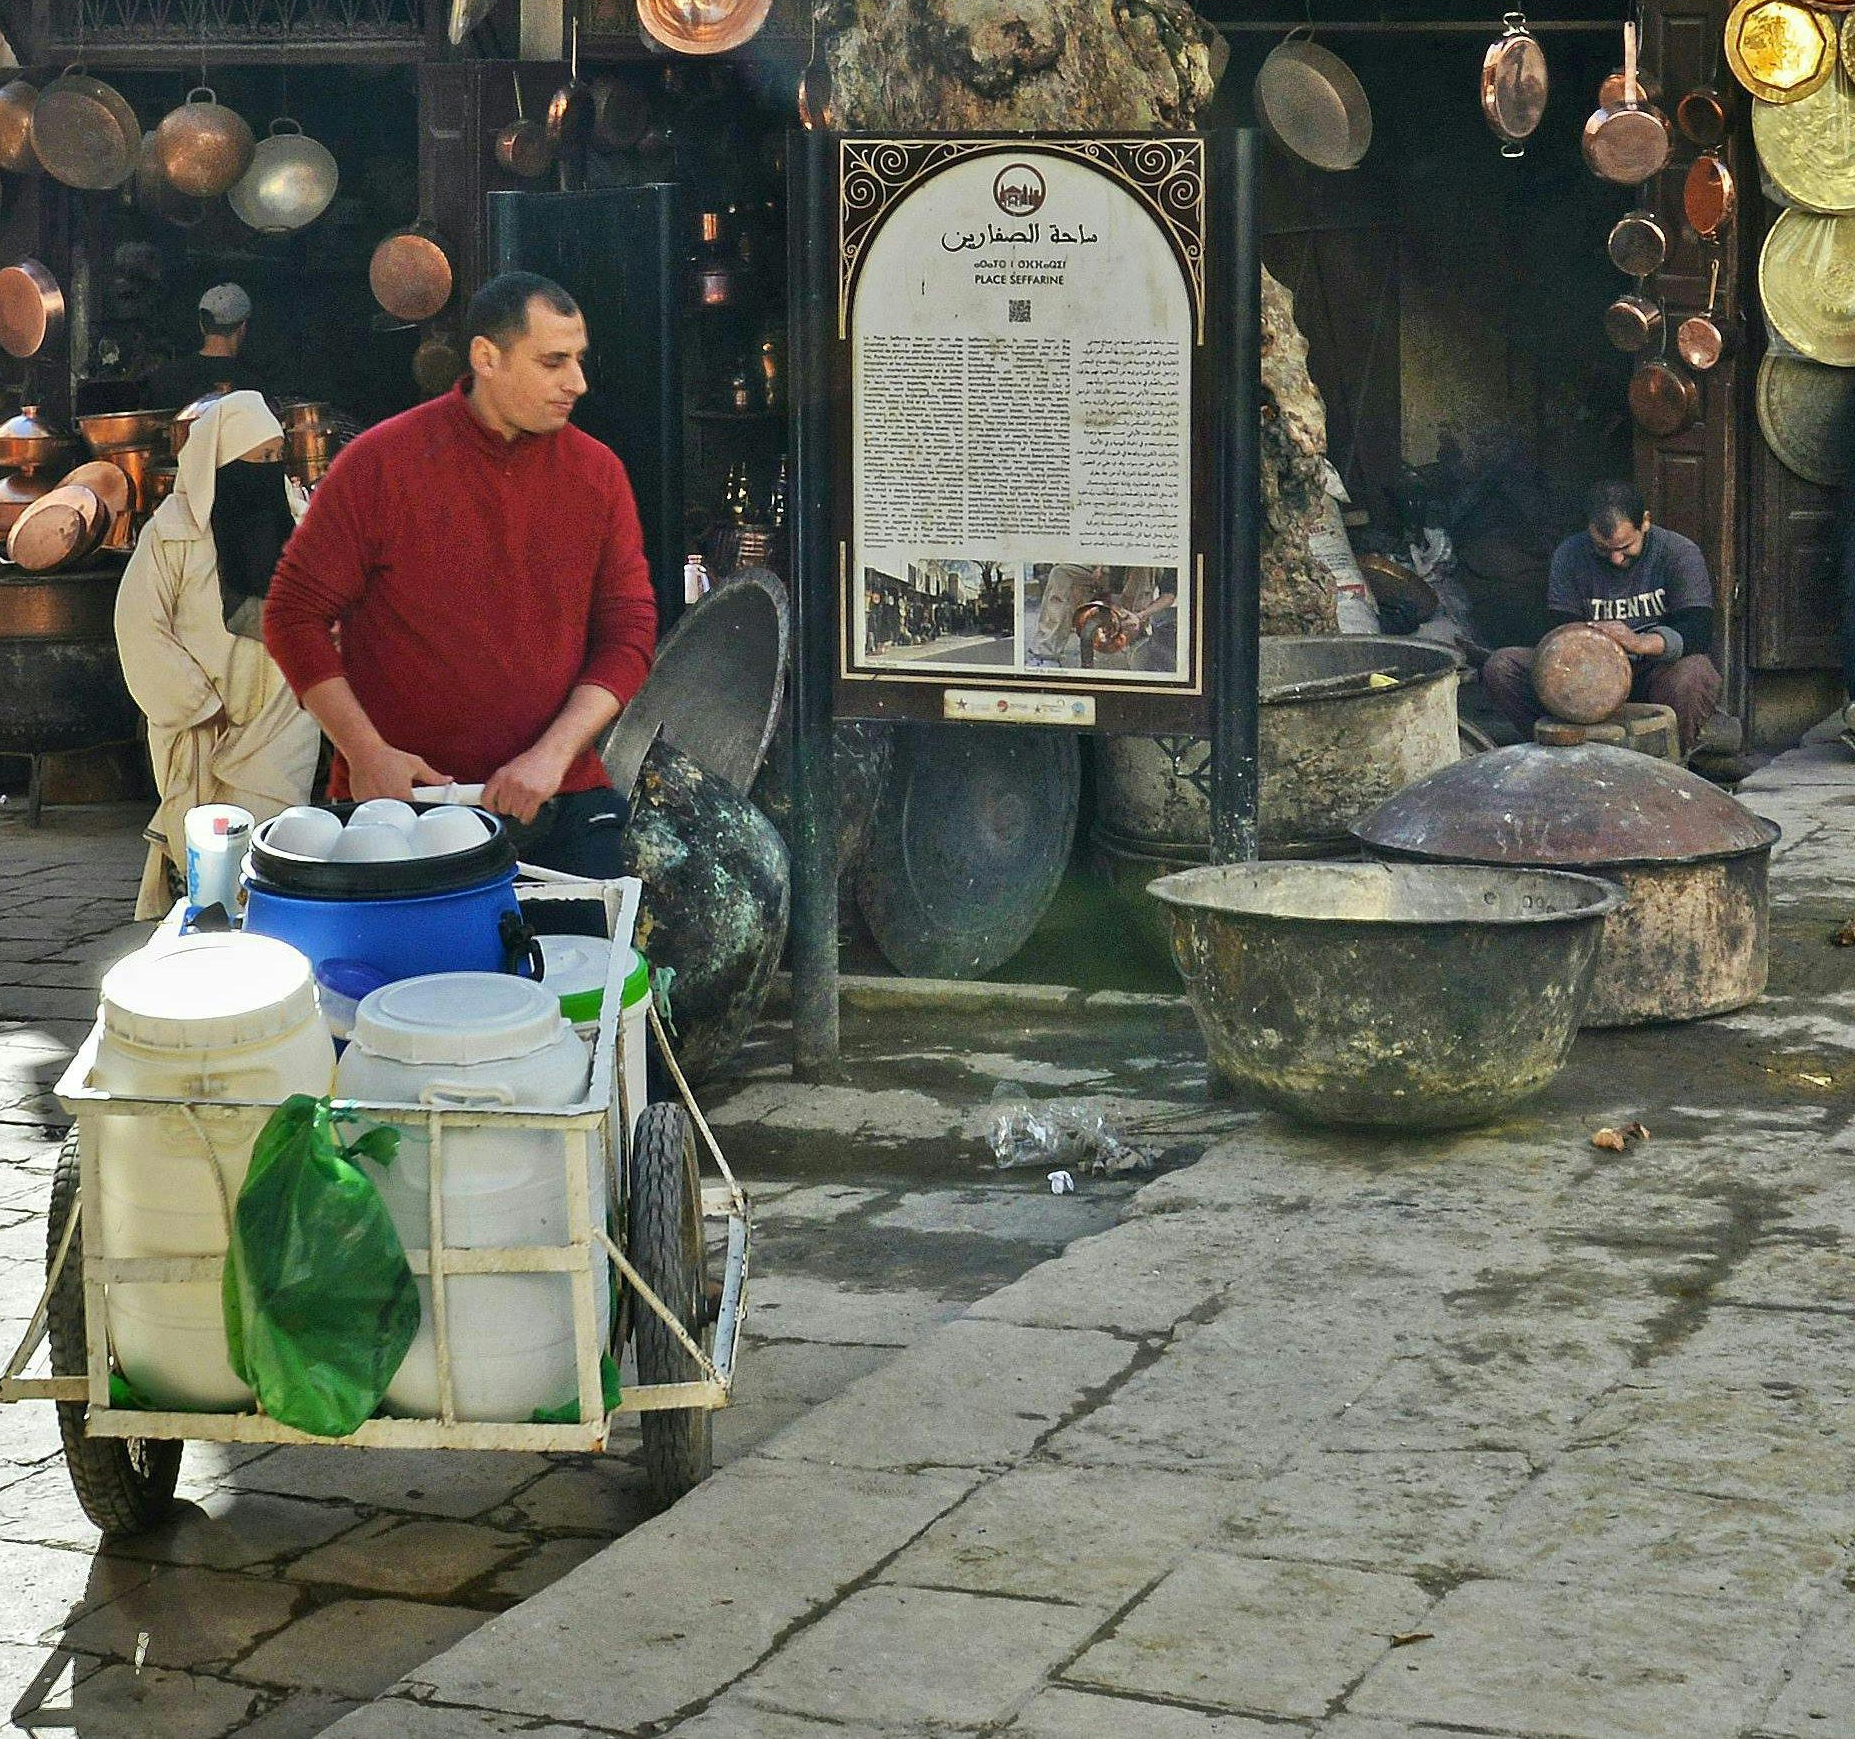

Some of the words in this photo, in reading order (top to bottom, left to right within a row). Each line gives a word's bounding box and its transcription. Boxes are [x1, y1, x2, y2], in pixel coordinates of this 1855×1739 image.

[941, 222, 1040, 253] الصفارين
[1049, 224, 1098, 245] ساحة
[975, 275, 1007, 285] PLACE
[1010, 275, 1064, 285] SEFFARINE
